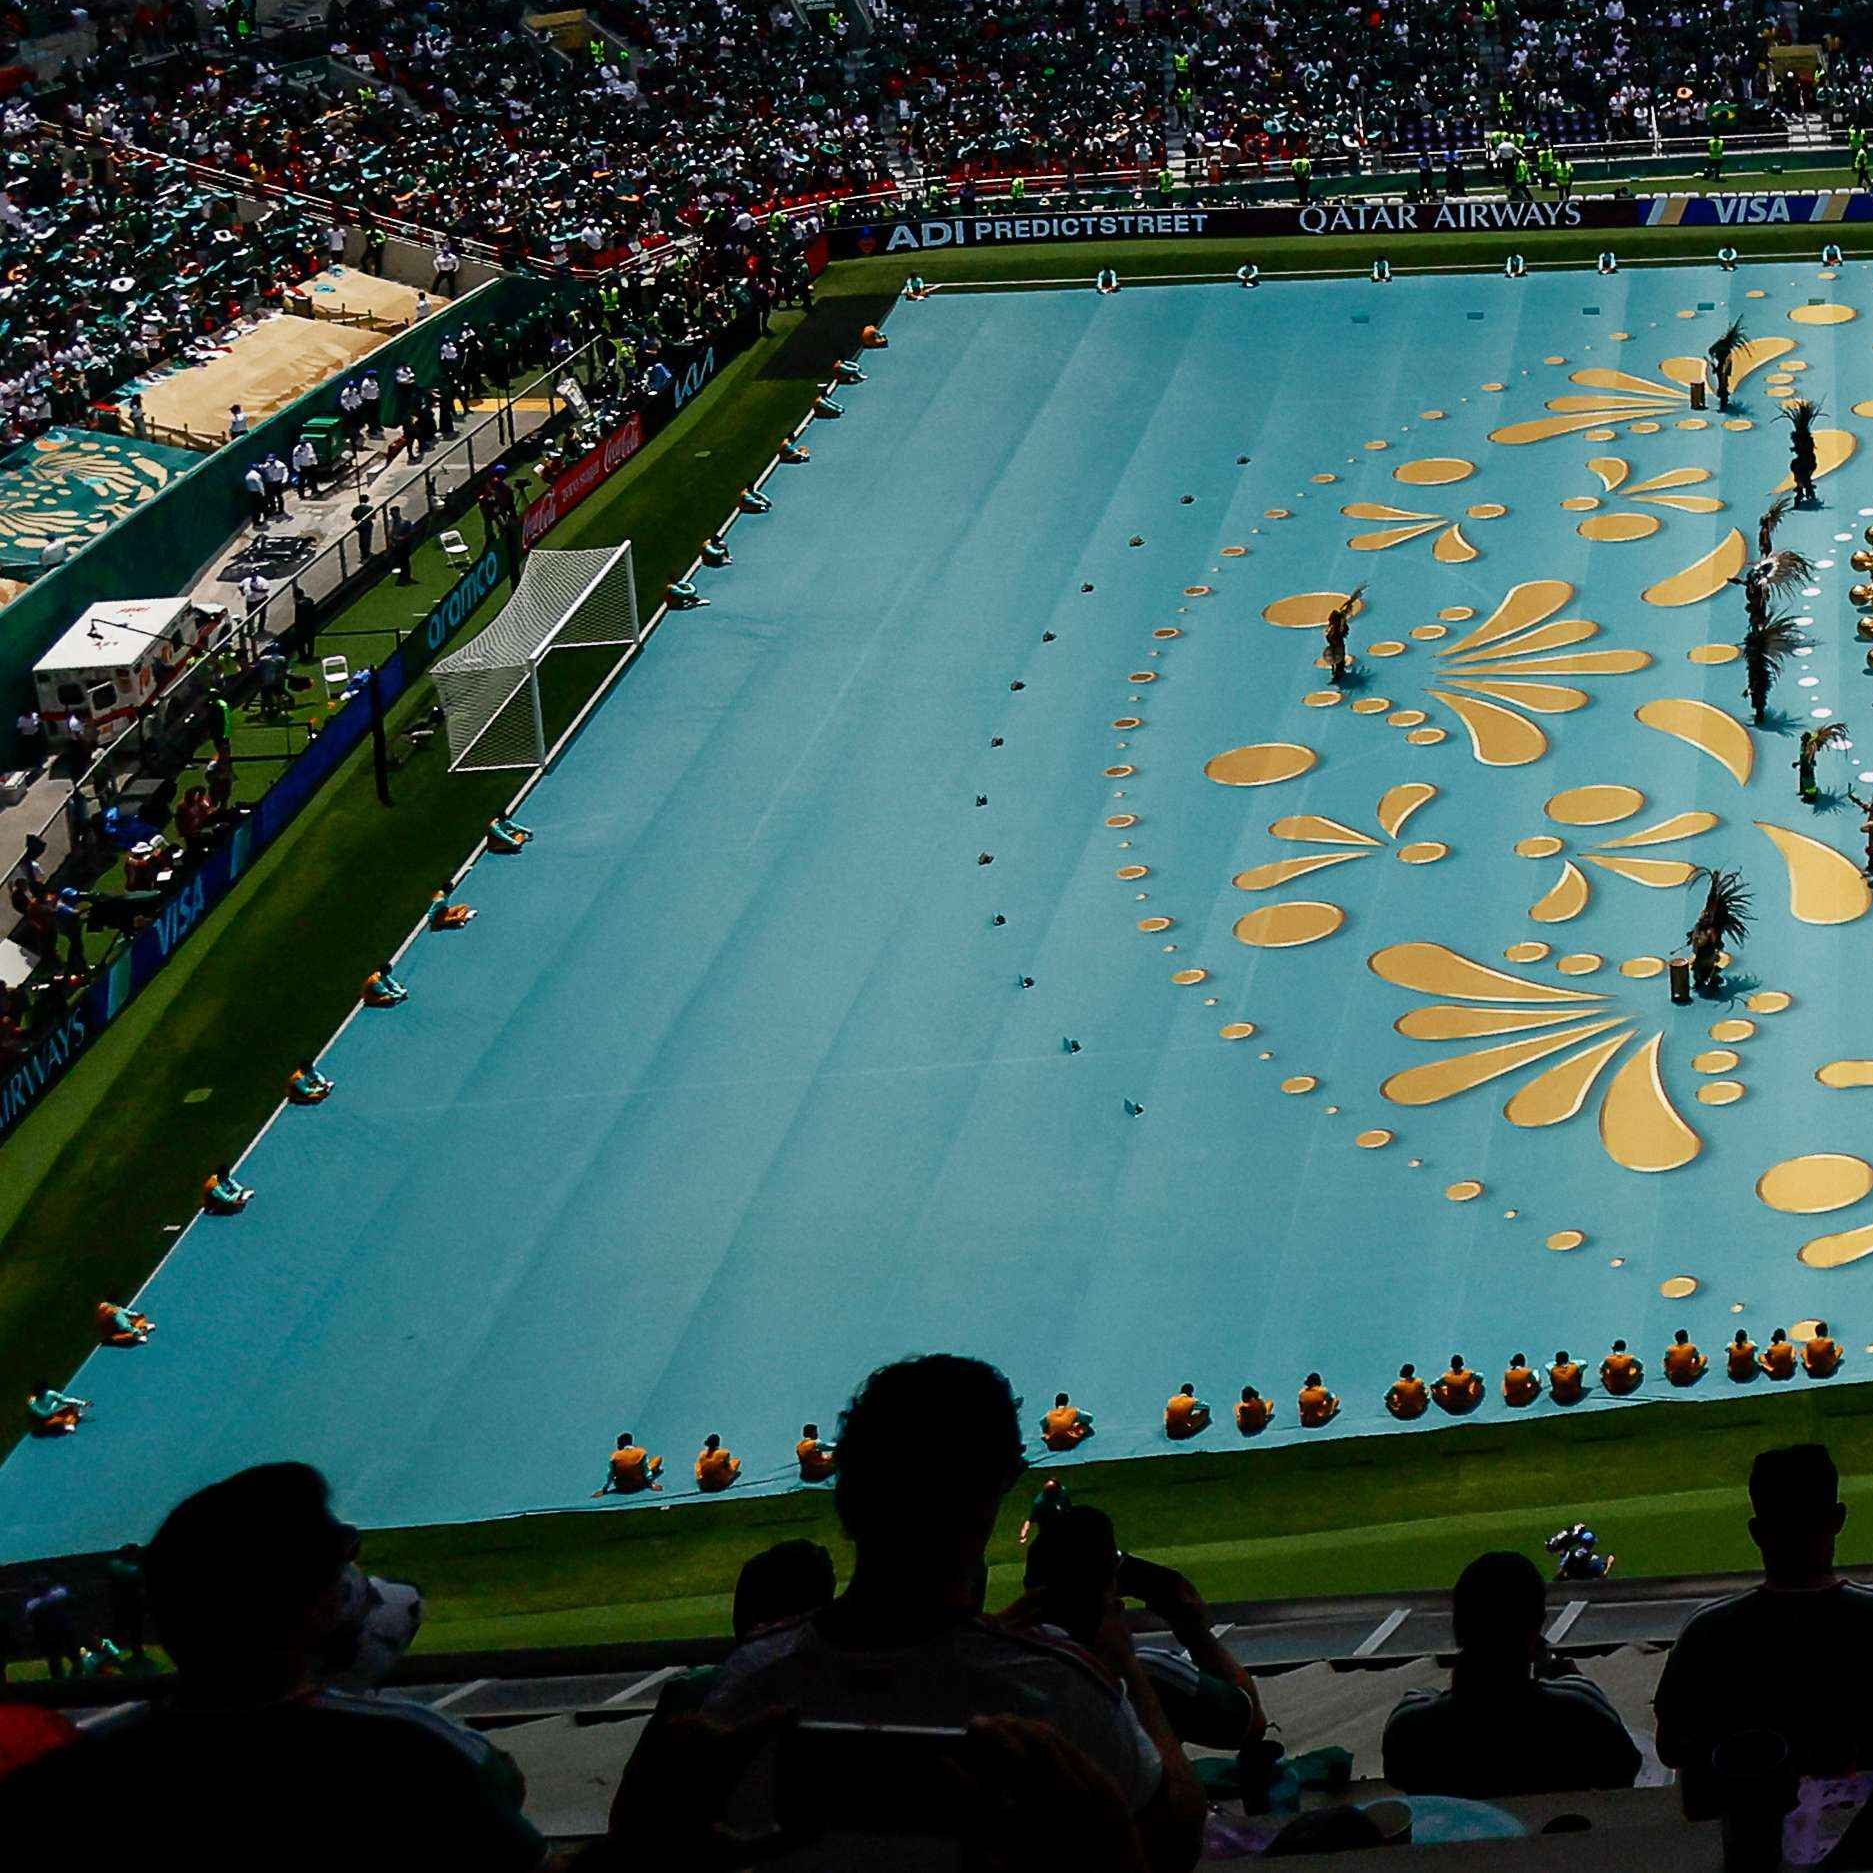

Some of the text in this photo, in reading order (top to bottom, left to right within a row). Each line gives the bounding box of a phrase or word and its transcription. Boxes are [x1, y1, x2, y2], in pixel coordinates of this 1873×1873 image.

[1299, 201, 1582, 233] QATAR AIRWAYS
[1711, 197, 1790, 224] VISA
[885, 214, 1208, 253] ADI PREDICTSTREET
[426, 550, 500, 651] aramco
